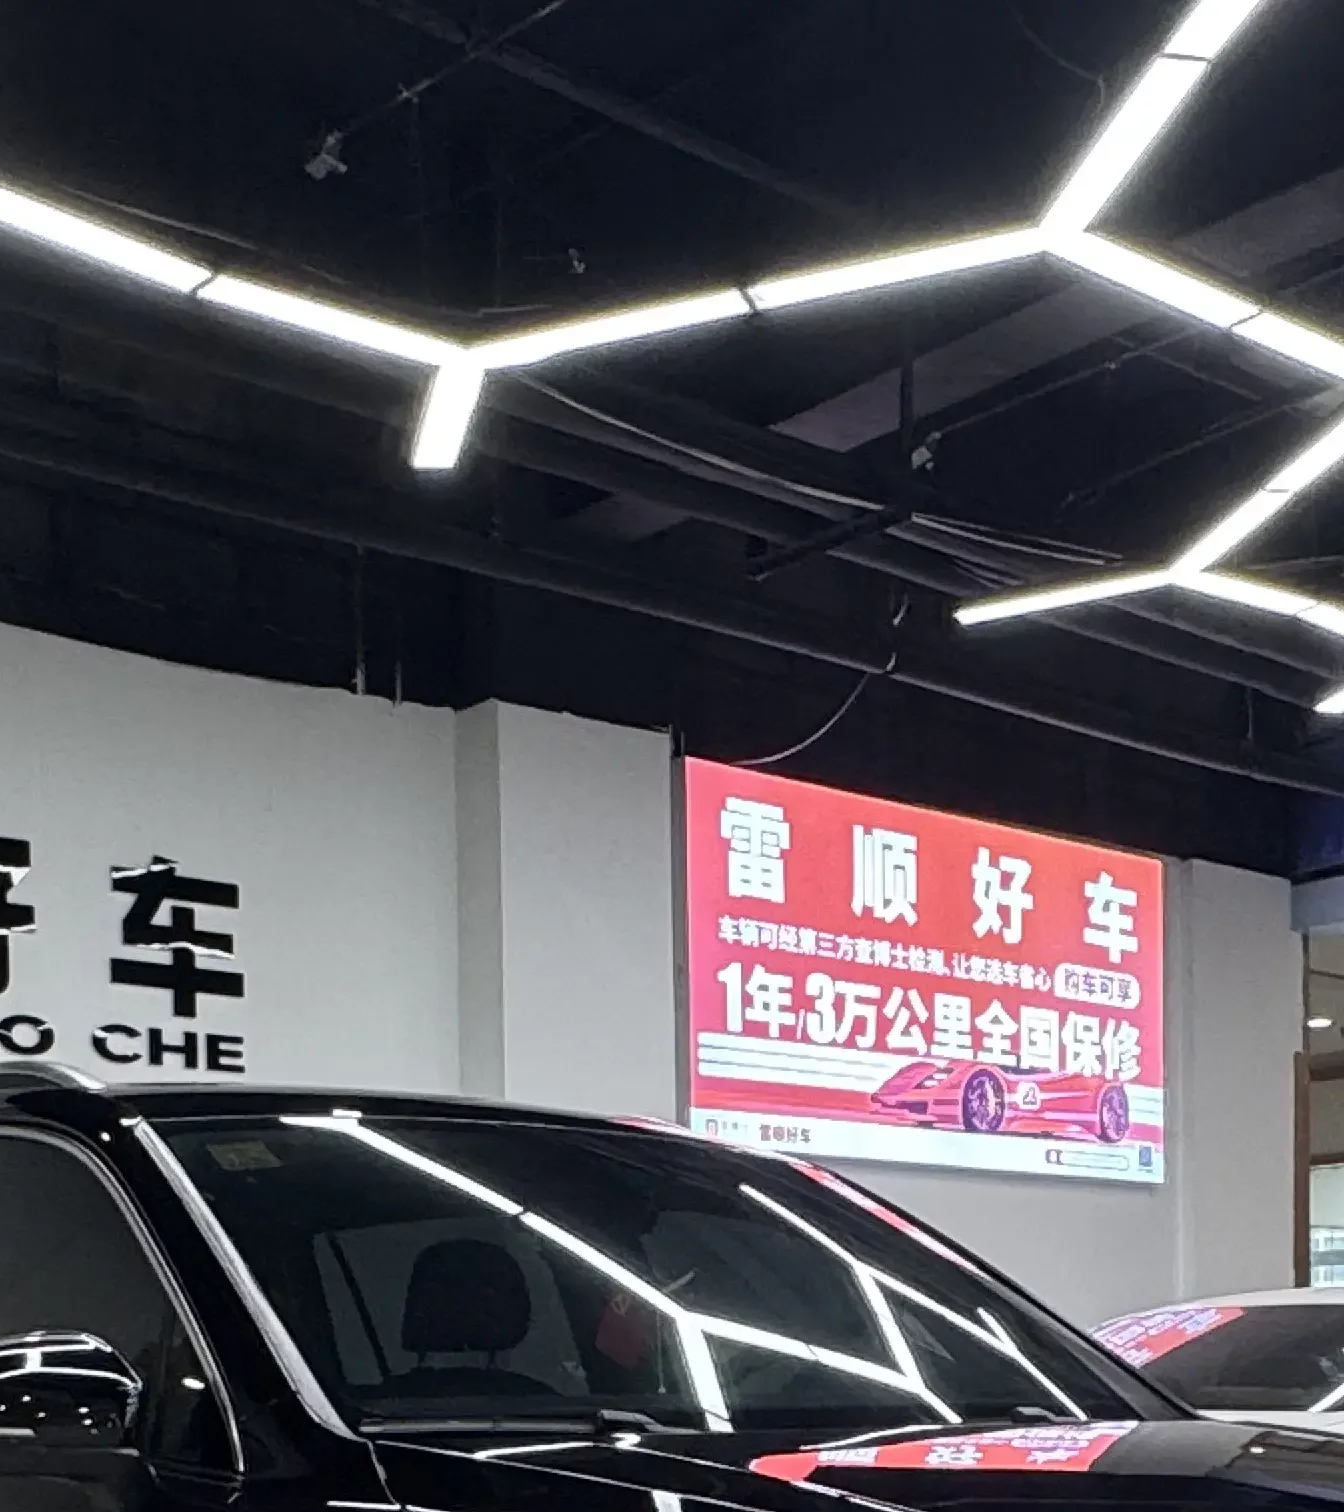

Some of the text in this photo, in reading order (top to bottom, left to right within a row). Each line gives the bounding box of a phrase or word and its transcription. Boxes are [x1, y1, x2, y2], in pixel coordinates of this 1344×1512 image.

[720, 797, 1138, 963] 雷顺好车
[93, 1024, 246, 1073] CHE
